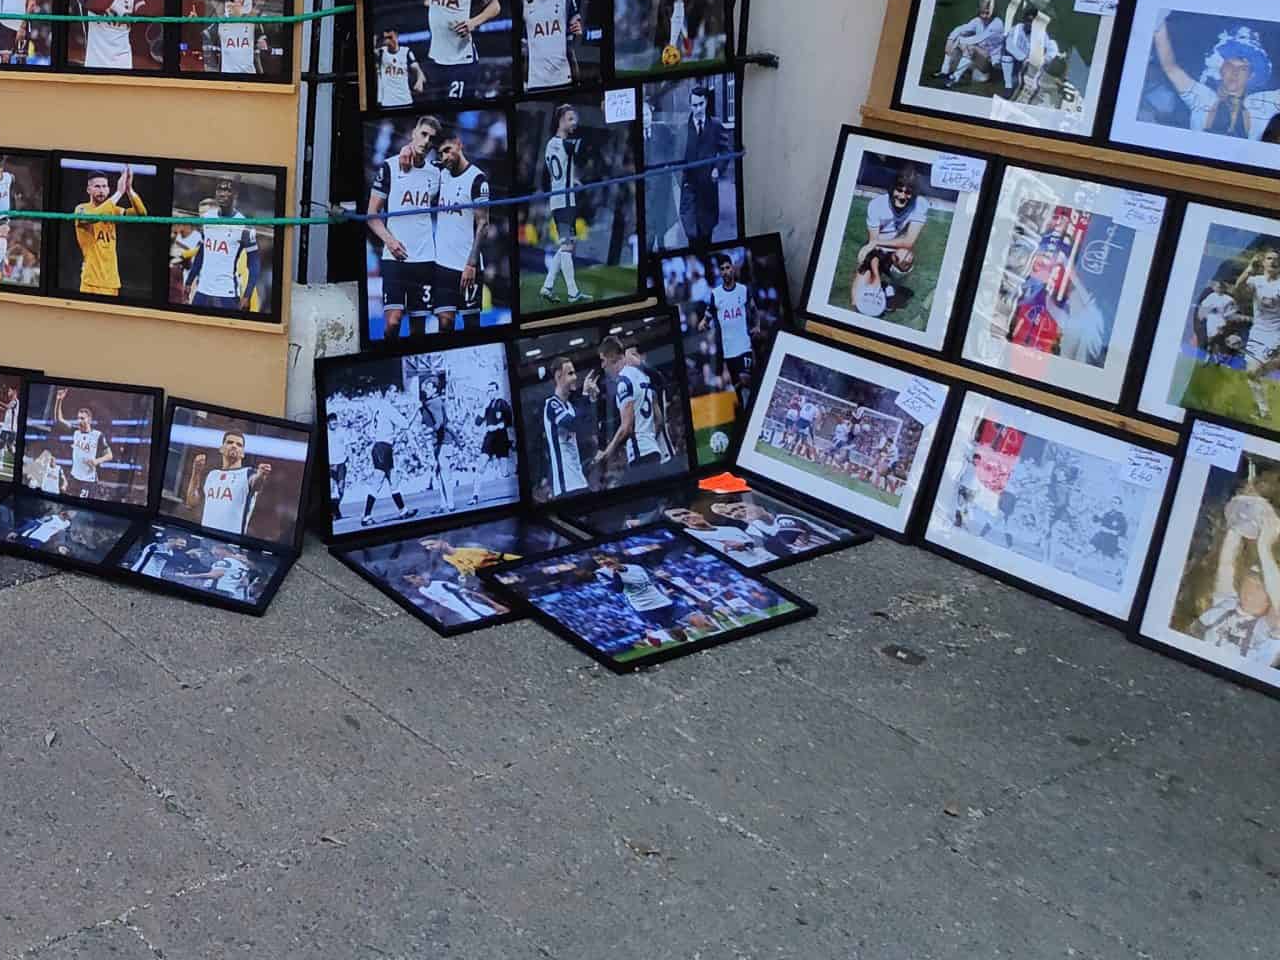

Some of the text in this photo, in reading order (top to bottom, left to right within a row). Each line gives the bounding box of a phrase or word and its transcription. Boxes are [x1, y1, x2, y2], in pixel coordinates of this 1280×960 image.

[533, 19, 562, 37] AIA
[448, 81, 465, 99] 21
[400, 190, 430, 207] AIA
[204, 238, 230, 255] AIA
[421, 284, 432, 302] 3
[723, 307, 742, 321] AIA
[207, 487, 233, 502] AIA
